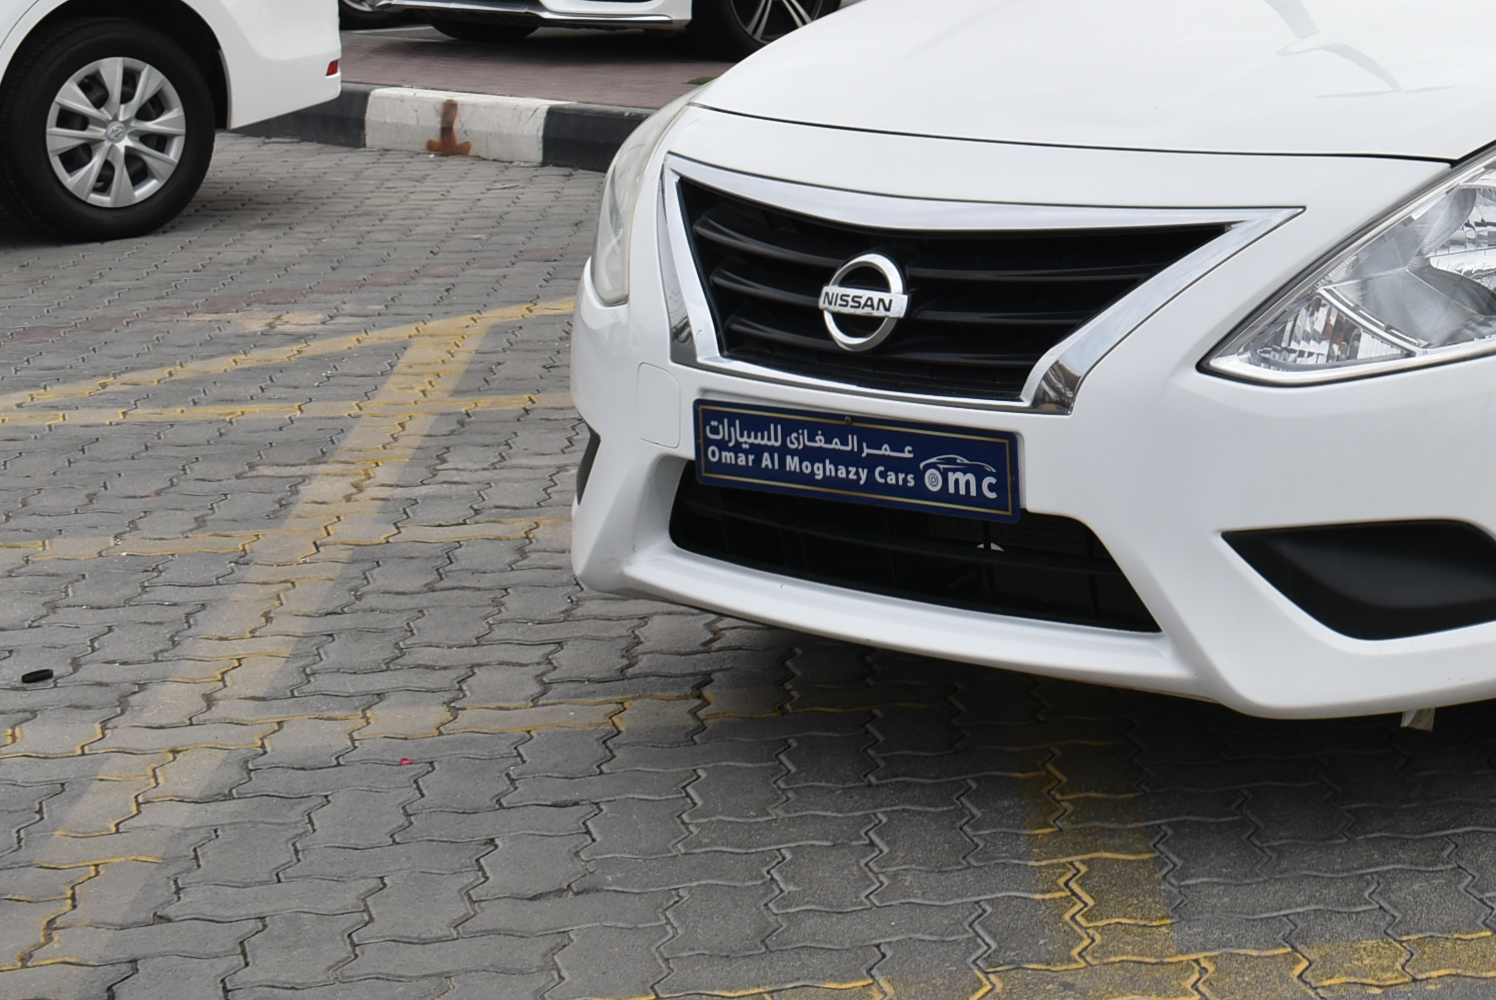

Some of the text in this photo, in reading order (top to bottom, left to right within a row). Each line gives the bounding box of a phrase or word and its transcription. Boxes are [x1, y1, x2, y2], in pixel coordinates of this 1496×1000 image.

[823, 291, 893, 313] NISSAN
[705, 418, 782, 450] للسيارات
[861, 440, 914, 458] عمر
[707, 445, 915, 487] Omar Al Moghazy Cars
